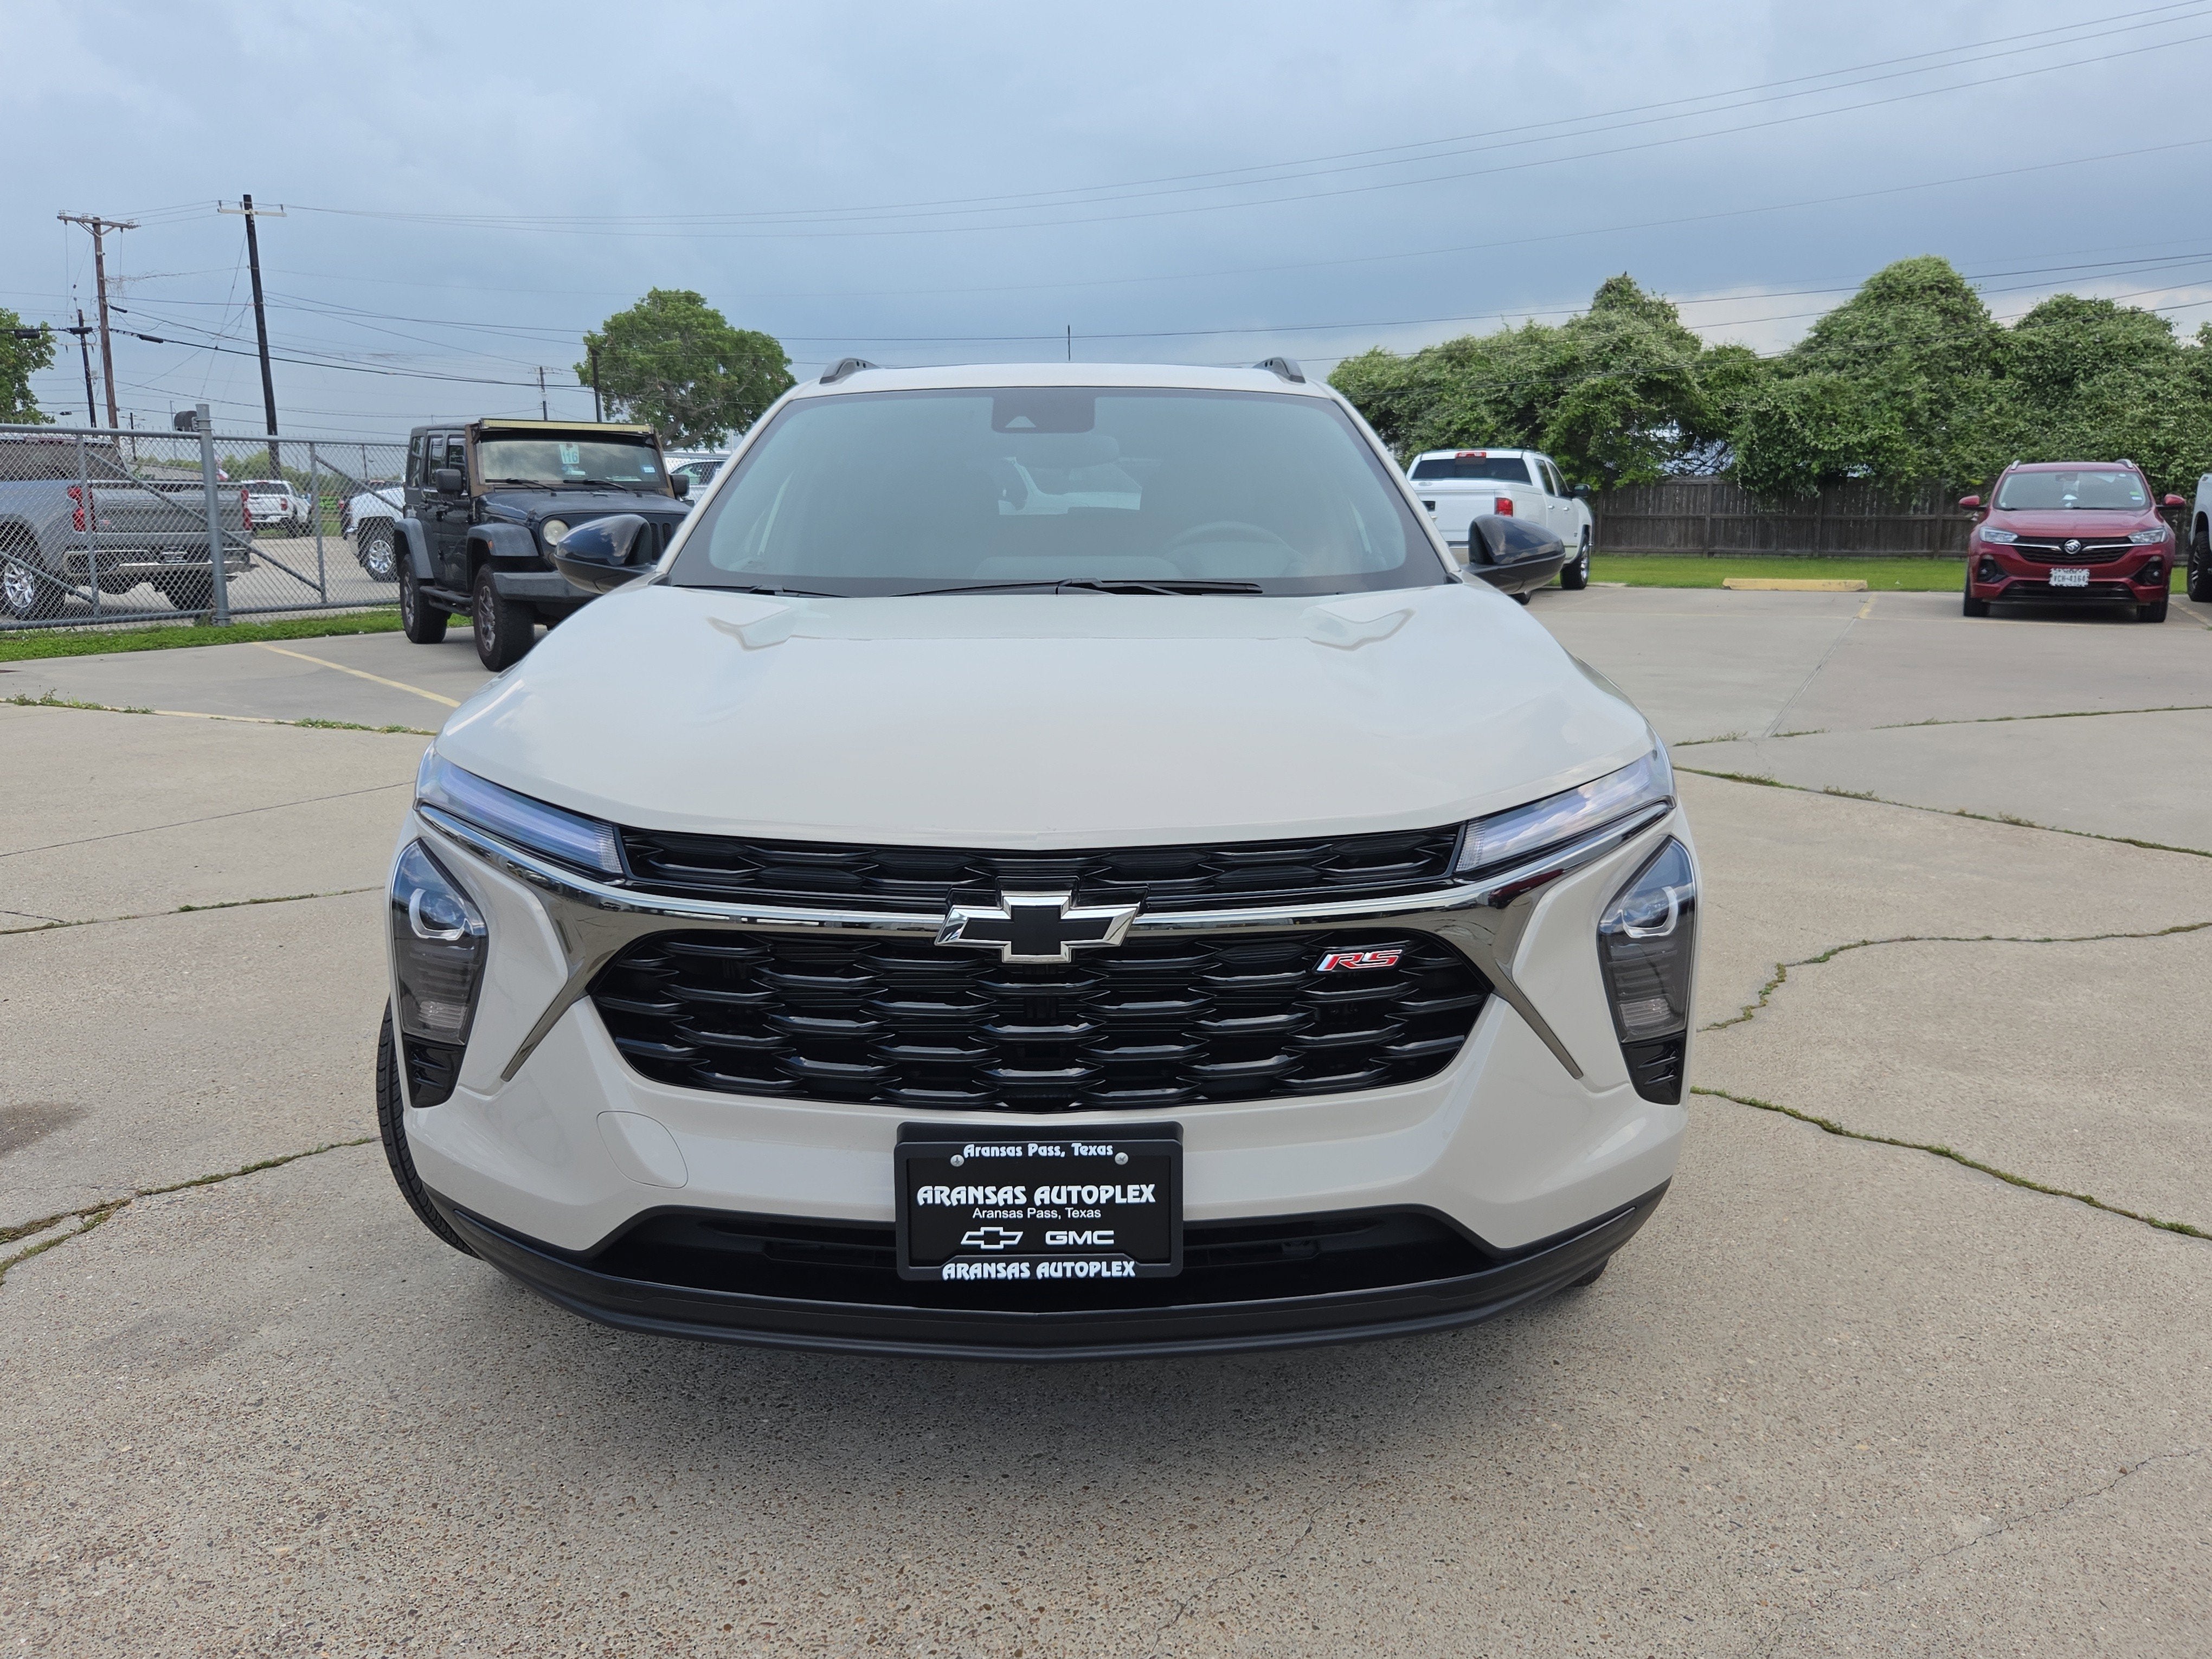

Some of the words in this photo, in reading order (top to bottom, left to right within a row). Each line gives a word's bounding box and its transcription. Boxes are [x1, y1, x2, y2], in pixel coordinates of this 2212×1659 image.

[1316, 949, 1403, 971] RS
[963, 1143, 1023, 1158] Aransas
[1027, 1143, 1065, 1158] Pass,
[1071, 1142, 1113, 1156] Texas
[917, 1185, 1027, 1207] ARANSAS
[1033, 1184, 1156, 1206] AUTOPLEX
[972, 1207, 1024, 1219] Aransas
[1027, 1207, 1062, 1220] Pass,
[1065, 1207, 1101, 1218] Texas
[1045, 1230, 1114, 1245] GMC
[942, 1262, 1031, 1280] ARANSAS
[1036, 1261, 1136, 1279] AUTOPLEX
